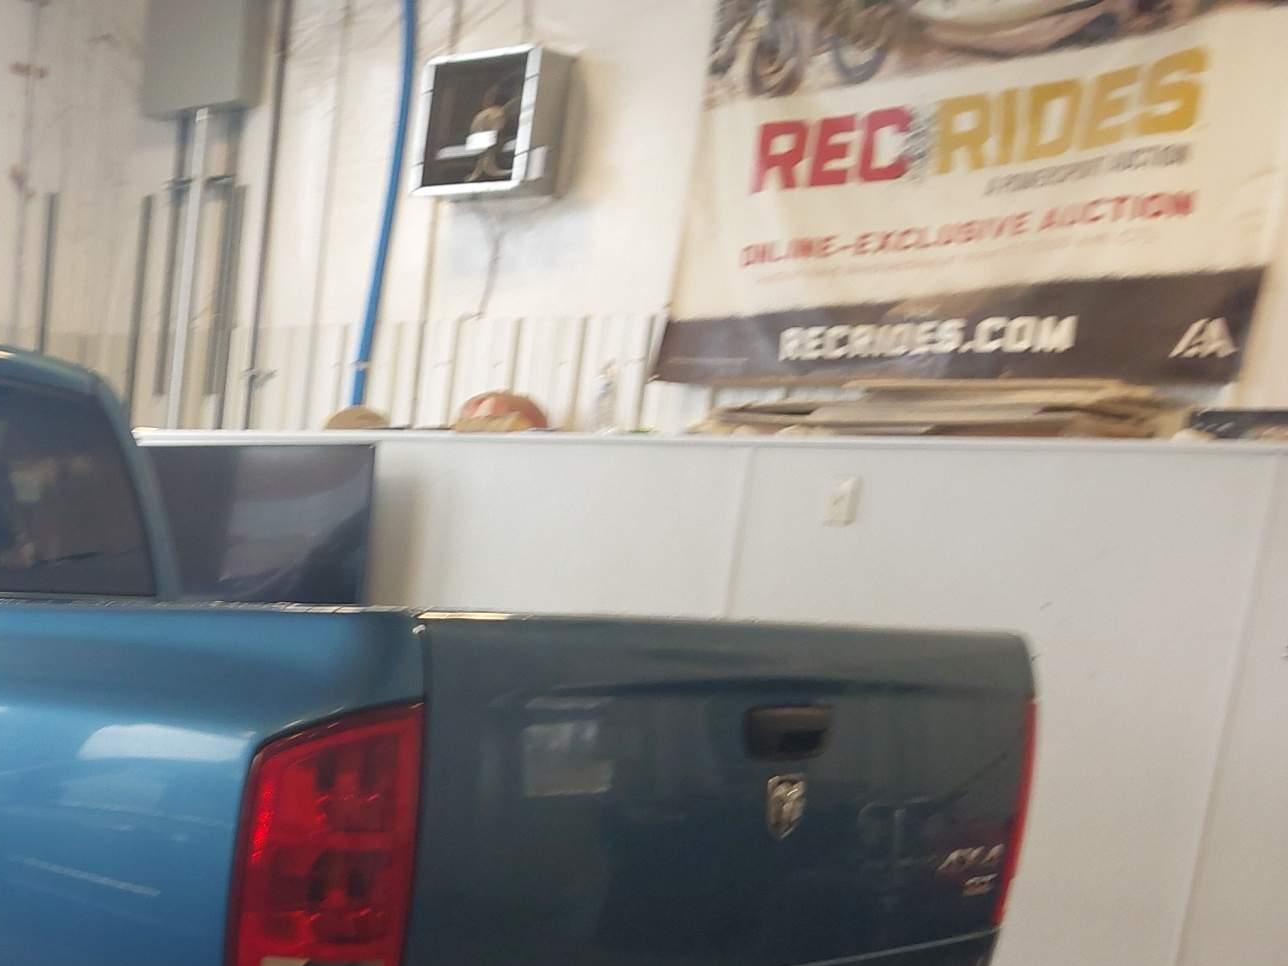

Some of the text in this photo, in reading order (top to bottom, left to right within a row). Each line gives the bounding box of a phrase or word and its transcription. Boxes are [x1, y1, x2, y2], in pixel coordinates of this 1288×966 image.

[752, 47, 1210, 193] REC RIDES
[739, 210, 1038, 268] ONLINE-EXCLUSIVE
[1038, 189, 1198, 232] AUCTION
[779, 314, 1079, 362] RECRIDES.COM
